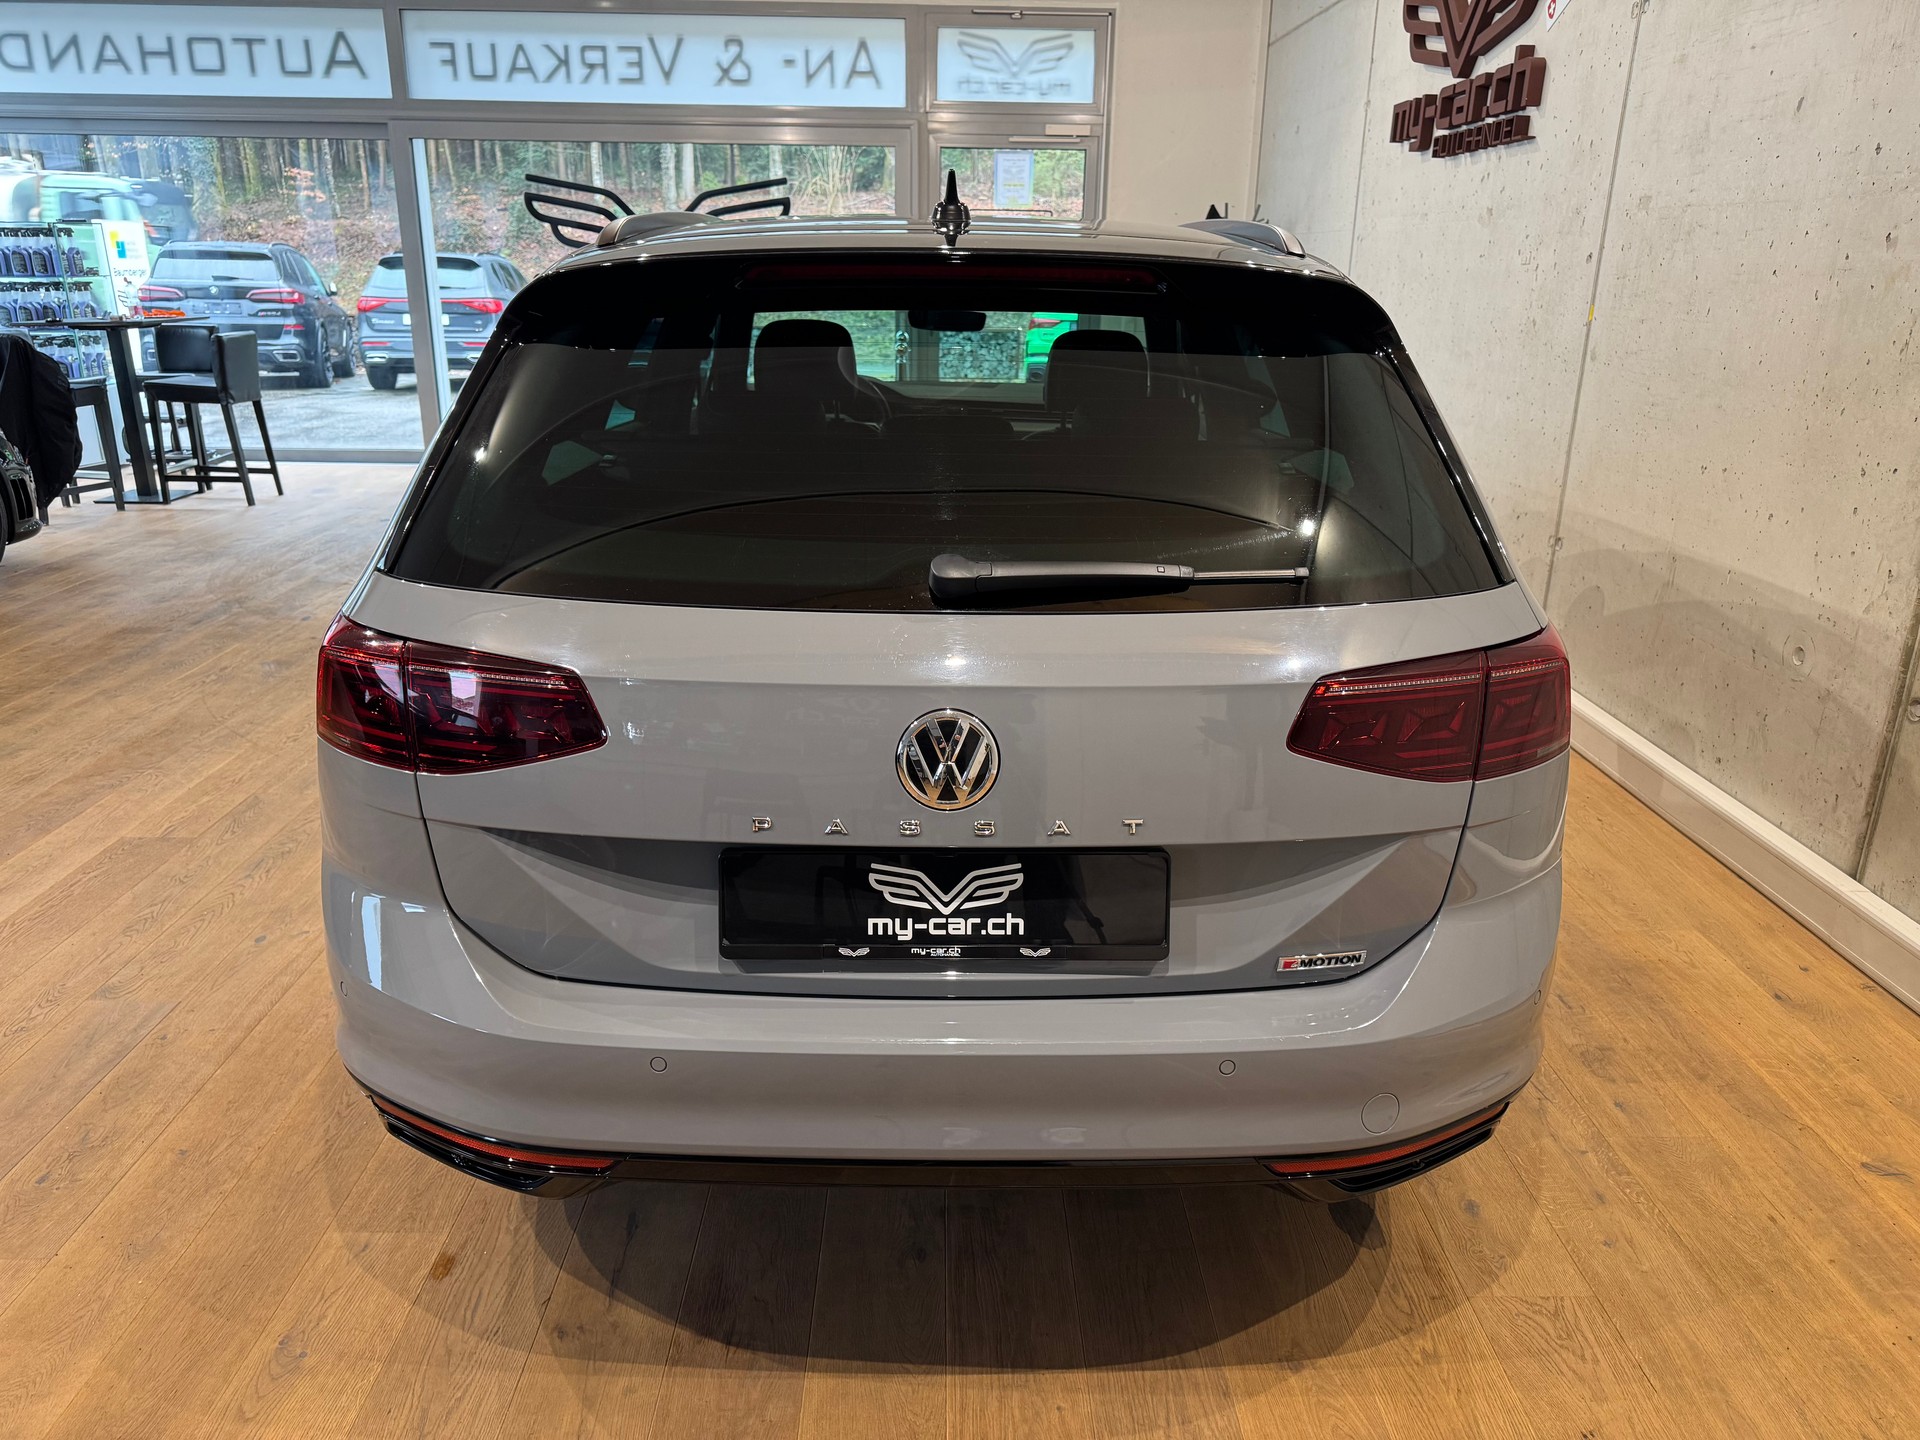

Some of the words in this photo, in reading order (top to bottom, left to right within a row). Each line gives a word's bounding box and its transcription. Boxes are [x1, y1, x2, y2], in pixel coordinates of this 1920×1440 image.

[1432, 115, 1536, 158] AUTOHANDEL
[752, 816, 1144, 837] PASSAT
[867, 912, 1025, 941] my-car.ch
[911, 946, 961, 956] my-car.ch
